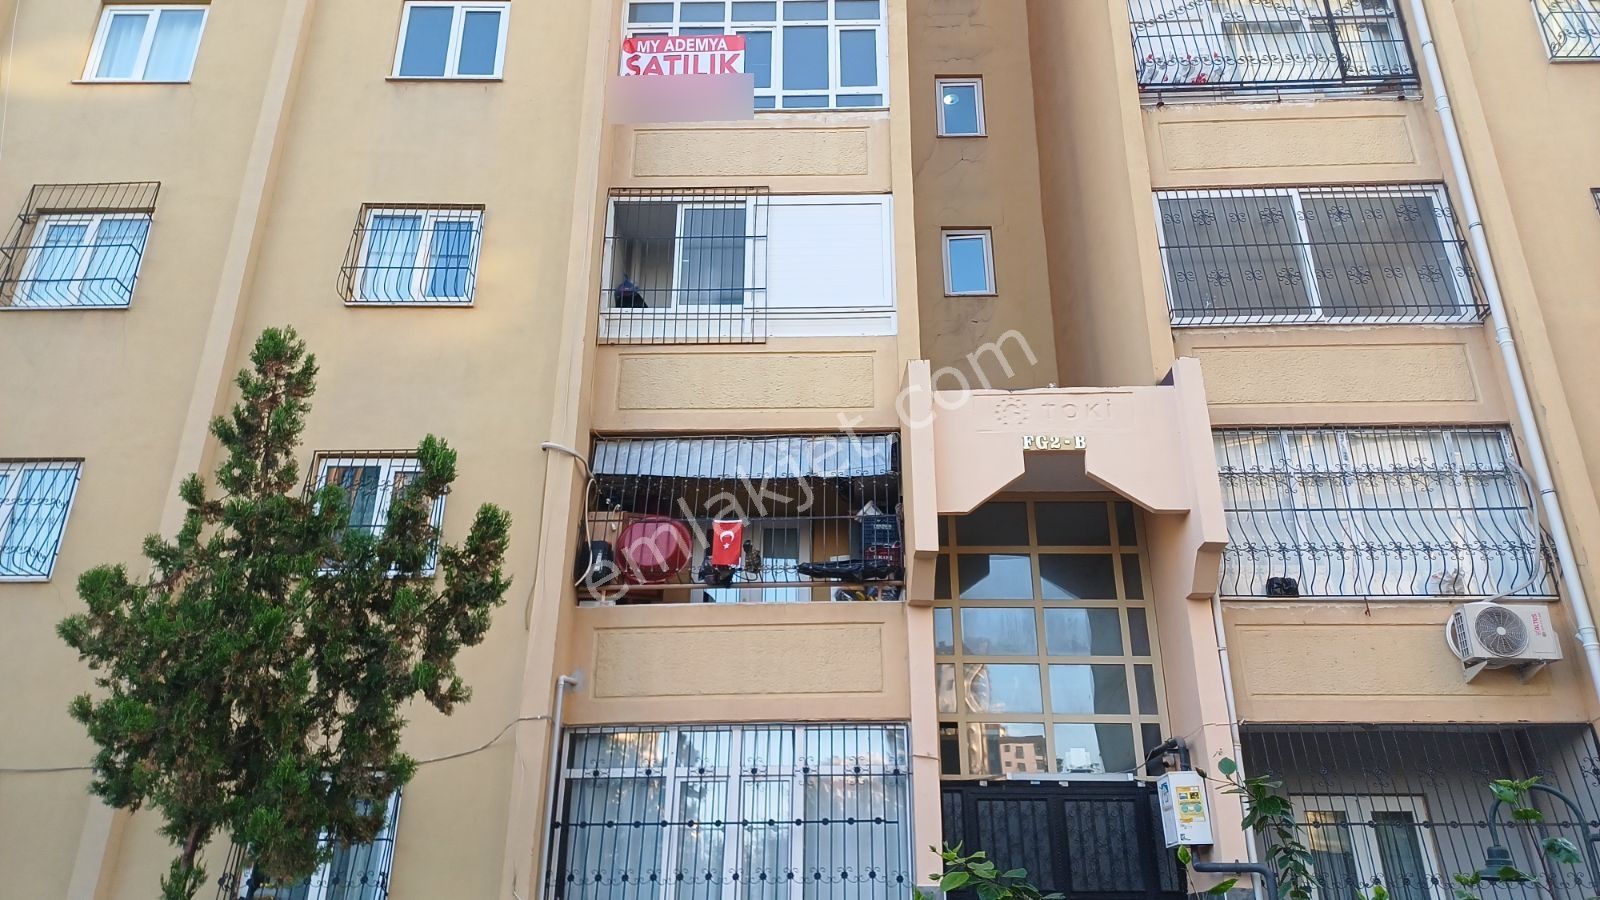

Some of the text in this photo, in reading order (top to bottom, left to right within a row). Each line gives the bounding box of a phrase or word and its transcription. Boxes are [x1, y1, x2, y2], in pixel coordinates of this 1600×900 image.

[637, 38, 728, 53] MY ADEMYA
[626, 53, 740, 75] SATILIK
